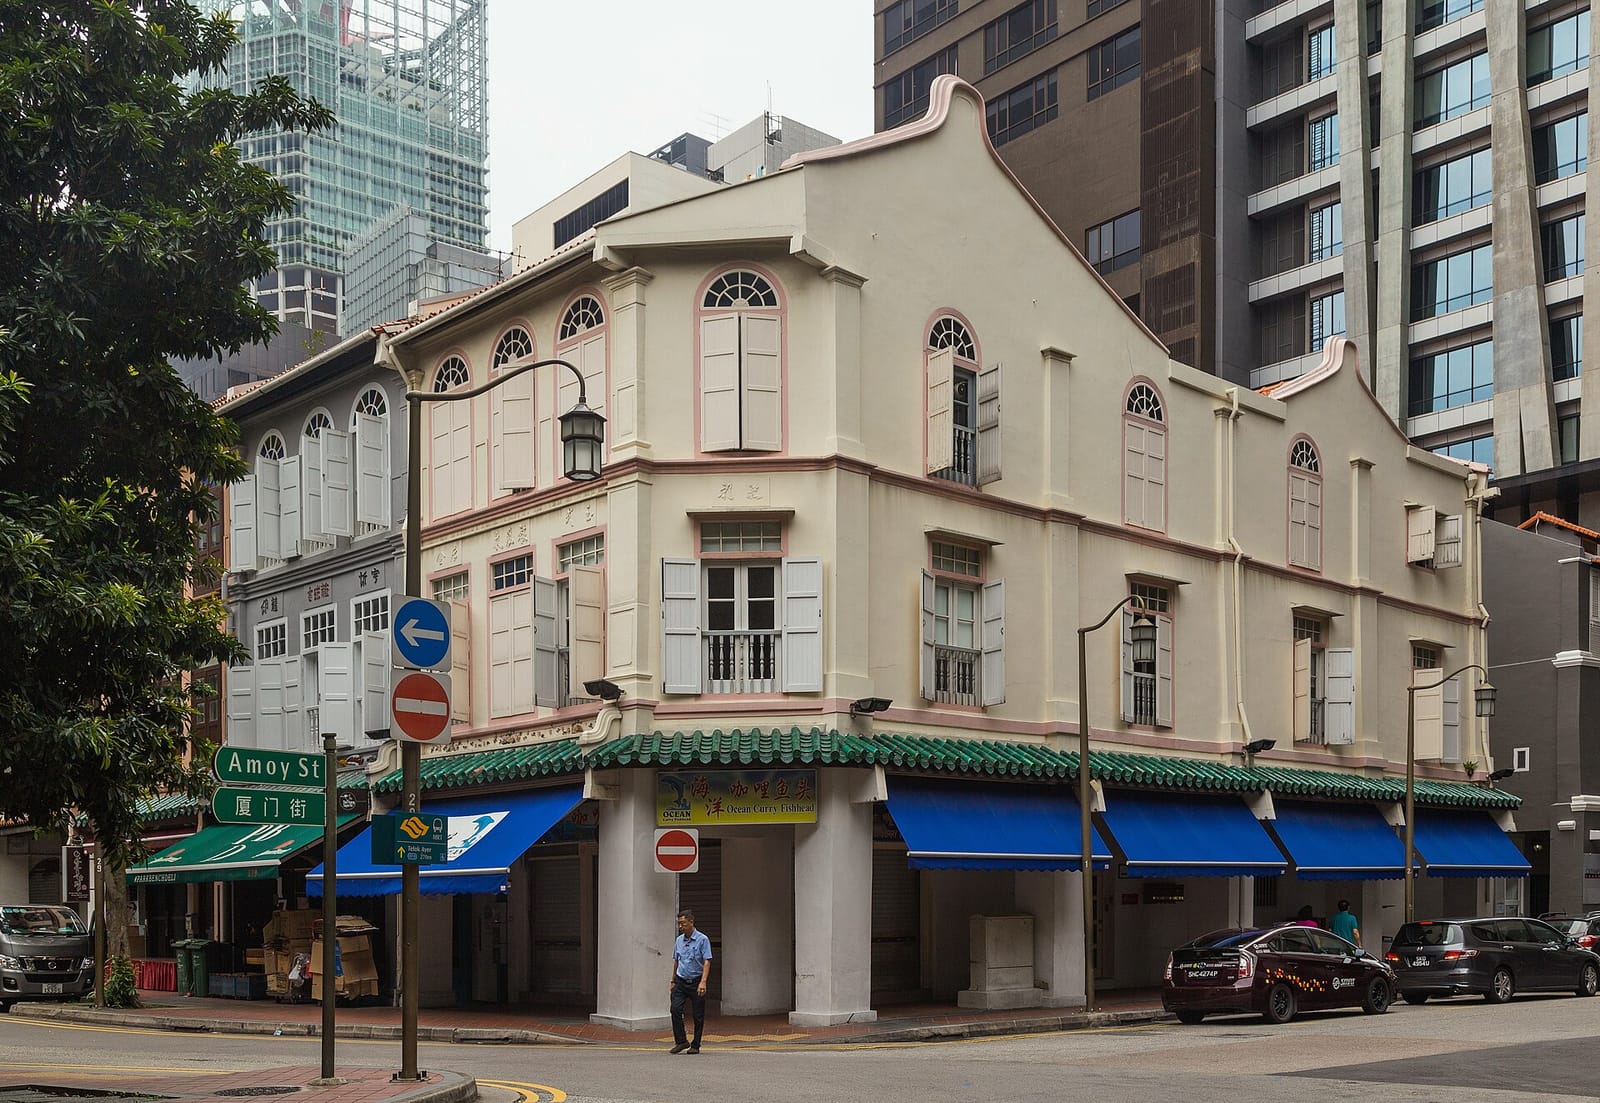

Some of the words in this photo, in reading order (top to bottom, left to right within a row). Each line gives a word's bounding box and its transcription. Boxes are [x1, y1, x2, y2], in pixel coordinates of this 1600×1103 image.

[228, 752, 290, 781] Amoy
[298, 757, 320, 778] St
[235, 796, 307, 819] 厦门街
[663, 810, 691, 818] OCEAN
[726, 804, 751, 814] Ocean
[753, 804, 777, 815] Curry
[780, 802, 814, 813] Fishhead
[1187, 970, 1218, 978] SHC4274P
